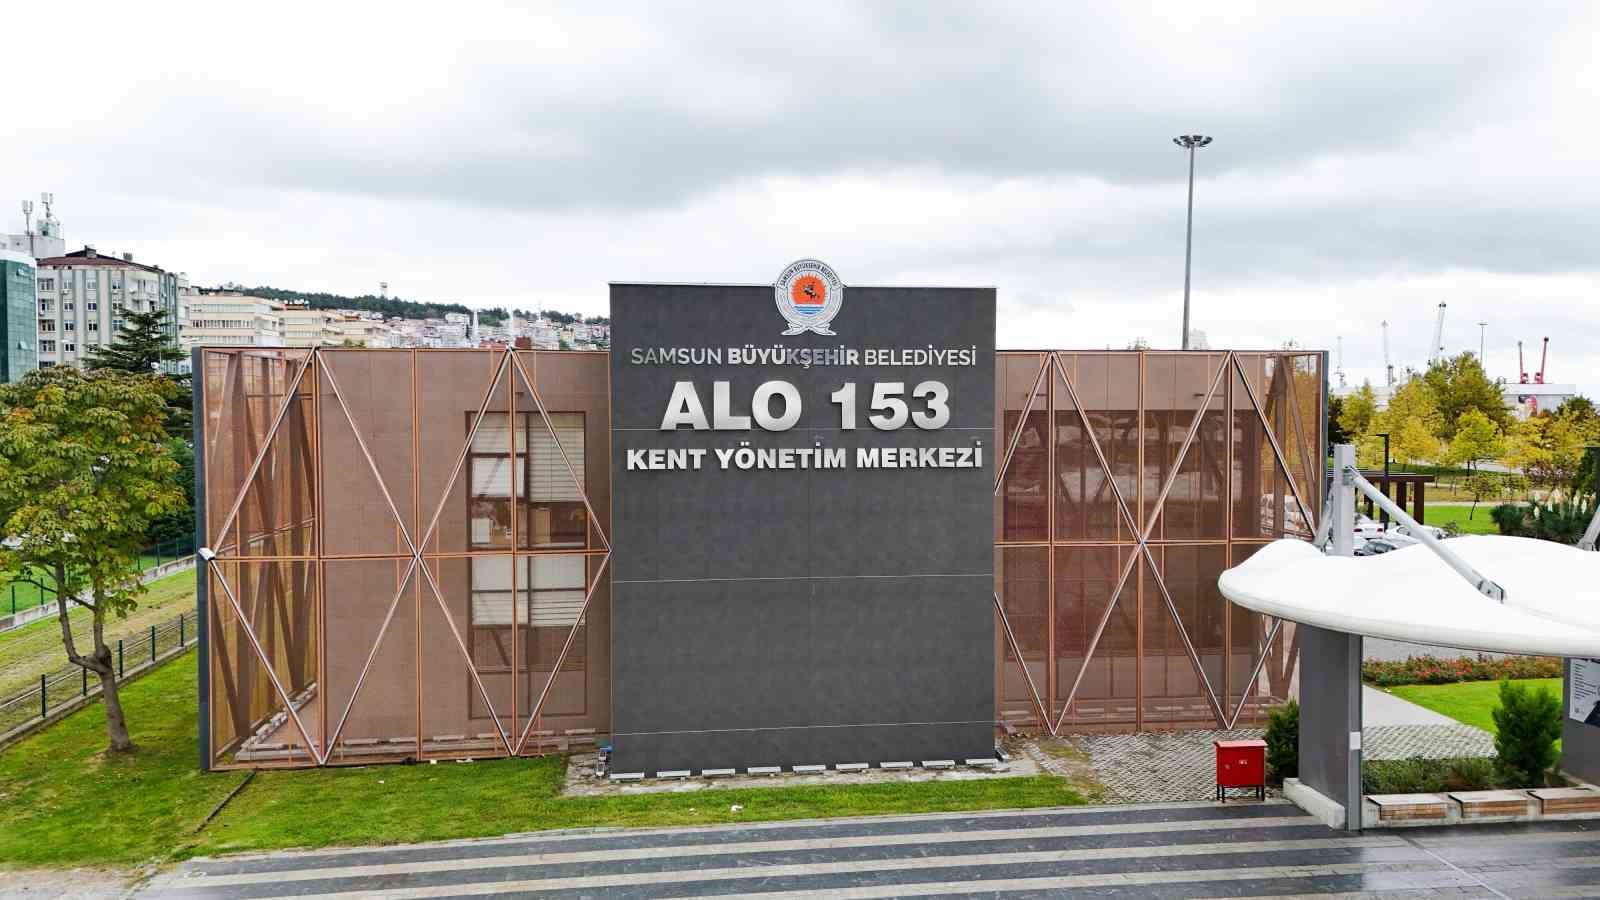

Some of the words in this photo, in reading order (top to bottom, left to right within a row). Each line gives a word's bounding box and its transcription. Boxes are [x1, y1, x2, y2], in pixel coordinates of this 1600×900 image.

[631, 348, 722, 366] SAMSUN
[728, 344, 859, 369] BÜYÜKŞEHİR
[864, 344, 977, 366] BELEDİYESİ
[660, 380, 802, 431] ALO
[831, 380, 950, 431] 153
[626, 448, 706, 470] KENT
[714, 441, 845, 470] YÖNETİM
[856, 440, 983, 469] MERKEZİ
